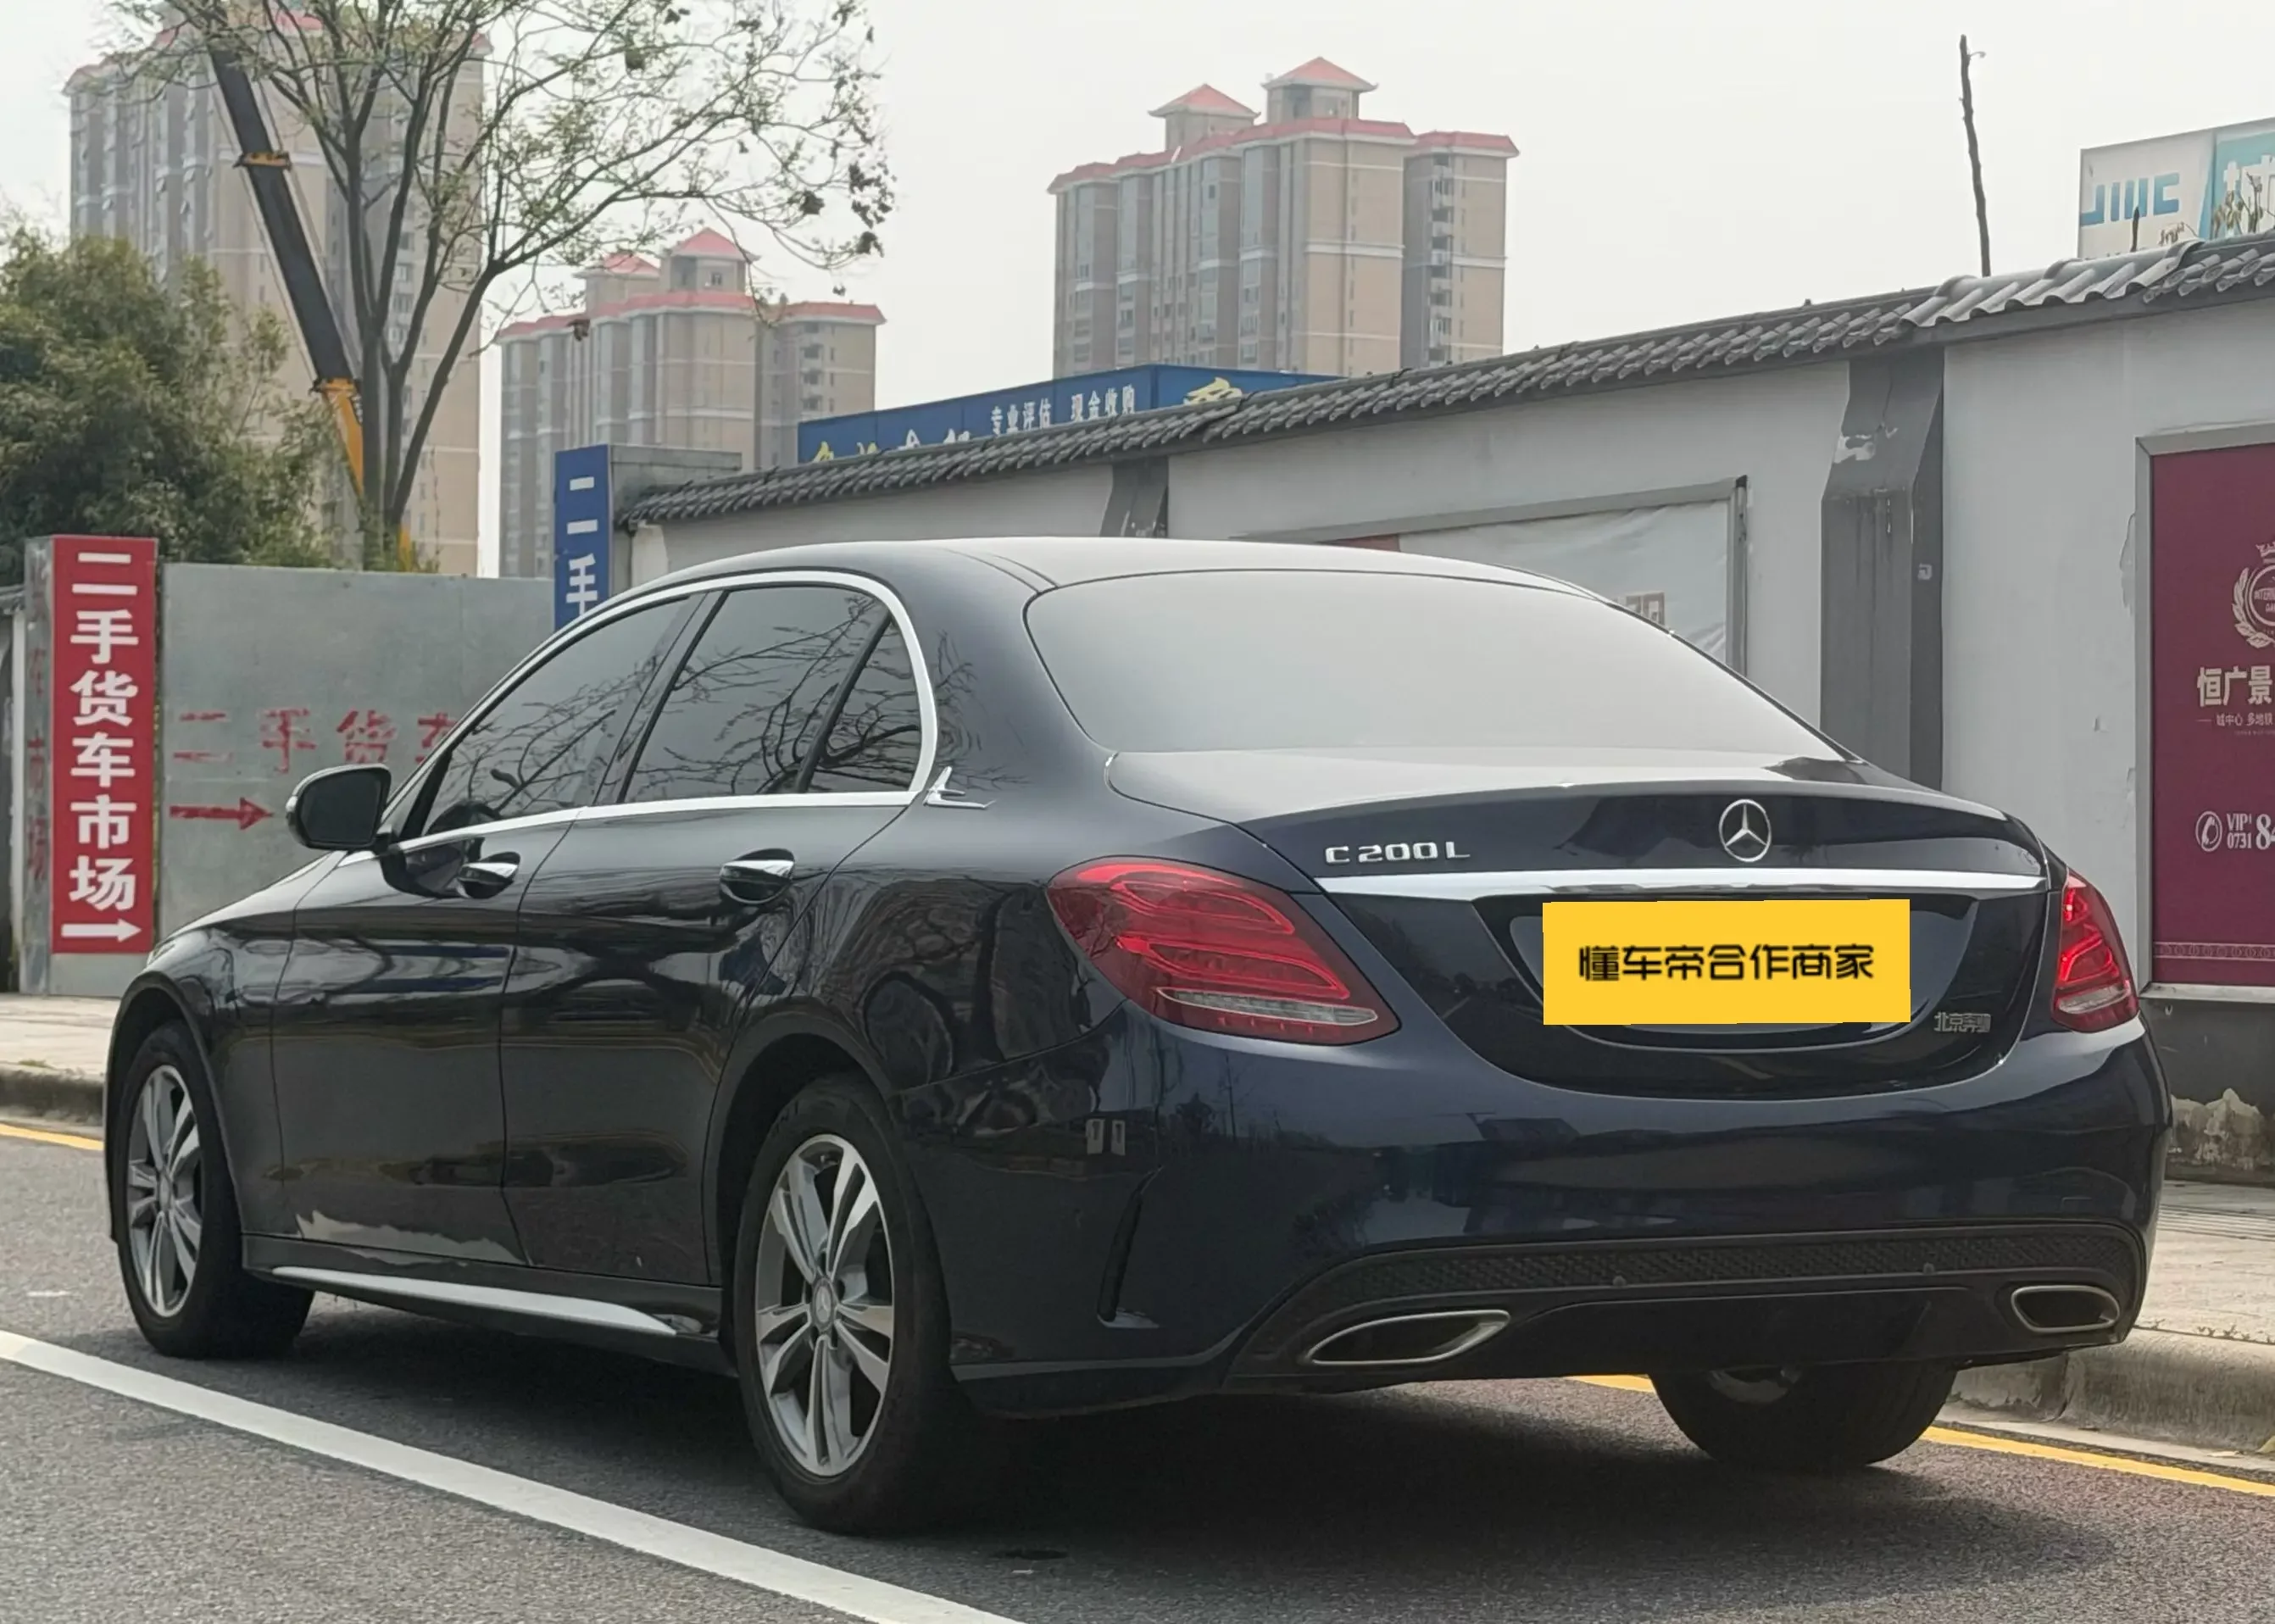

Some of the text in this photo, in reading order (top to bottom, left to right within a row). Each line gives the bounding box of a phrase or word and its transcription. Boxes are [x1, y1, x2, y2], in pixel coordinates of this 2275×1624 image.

[990, 384, 1136, 437] 专业评估 现金收购
[2197, 665, 2273, 707] 恒广景
[70, 552, 139, 911] 二手货车市场
[1326, 841, 1471, 864] C 200 L
[2227, 832, 2252, 848] 0731
